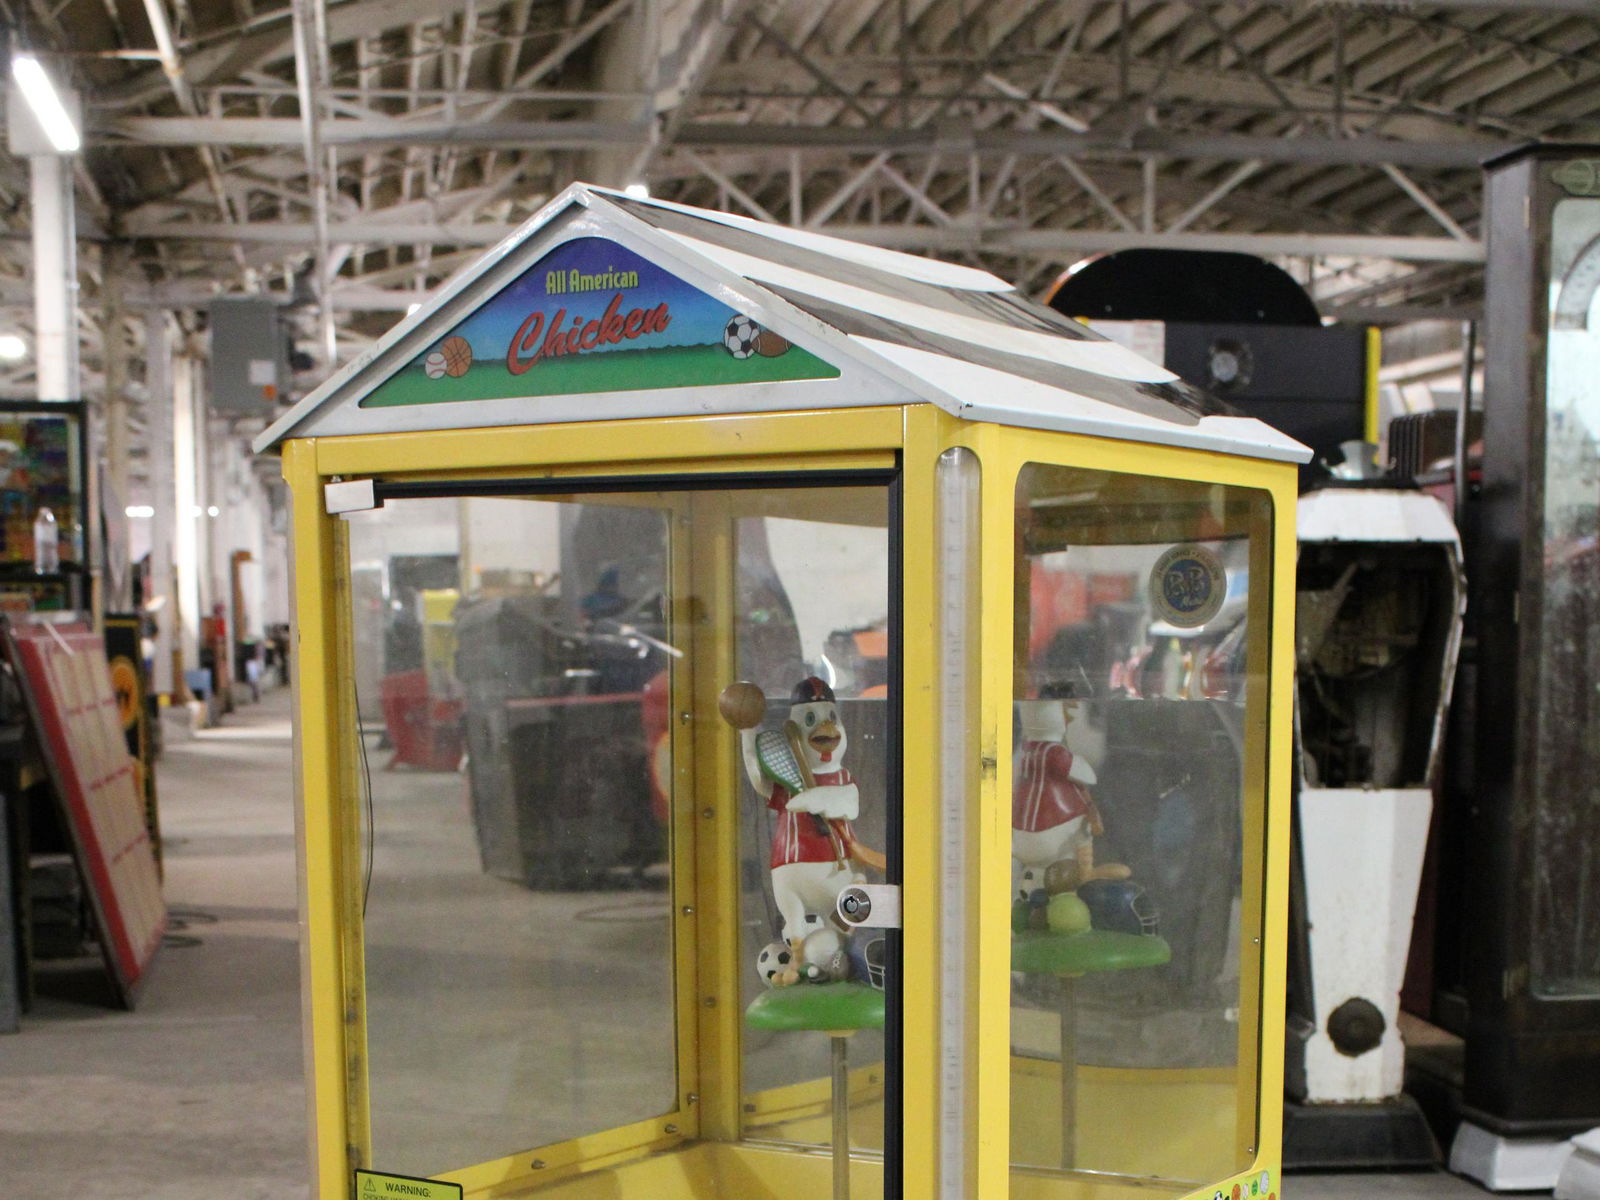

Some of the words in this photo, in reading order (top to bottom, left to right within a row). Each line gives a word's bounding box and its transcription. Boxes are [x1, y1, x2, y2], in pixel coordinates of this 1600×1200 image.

[546, 270, 566, 295] All
[569, 265, 638, 293] American
[507, 293, 672, 376] Chicken
[385, 1182, 431, 1198] WARNING:
